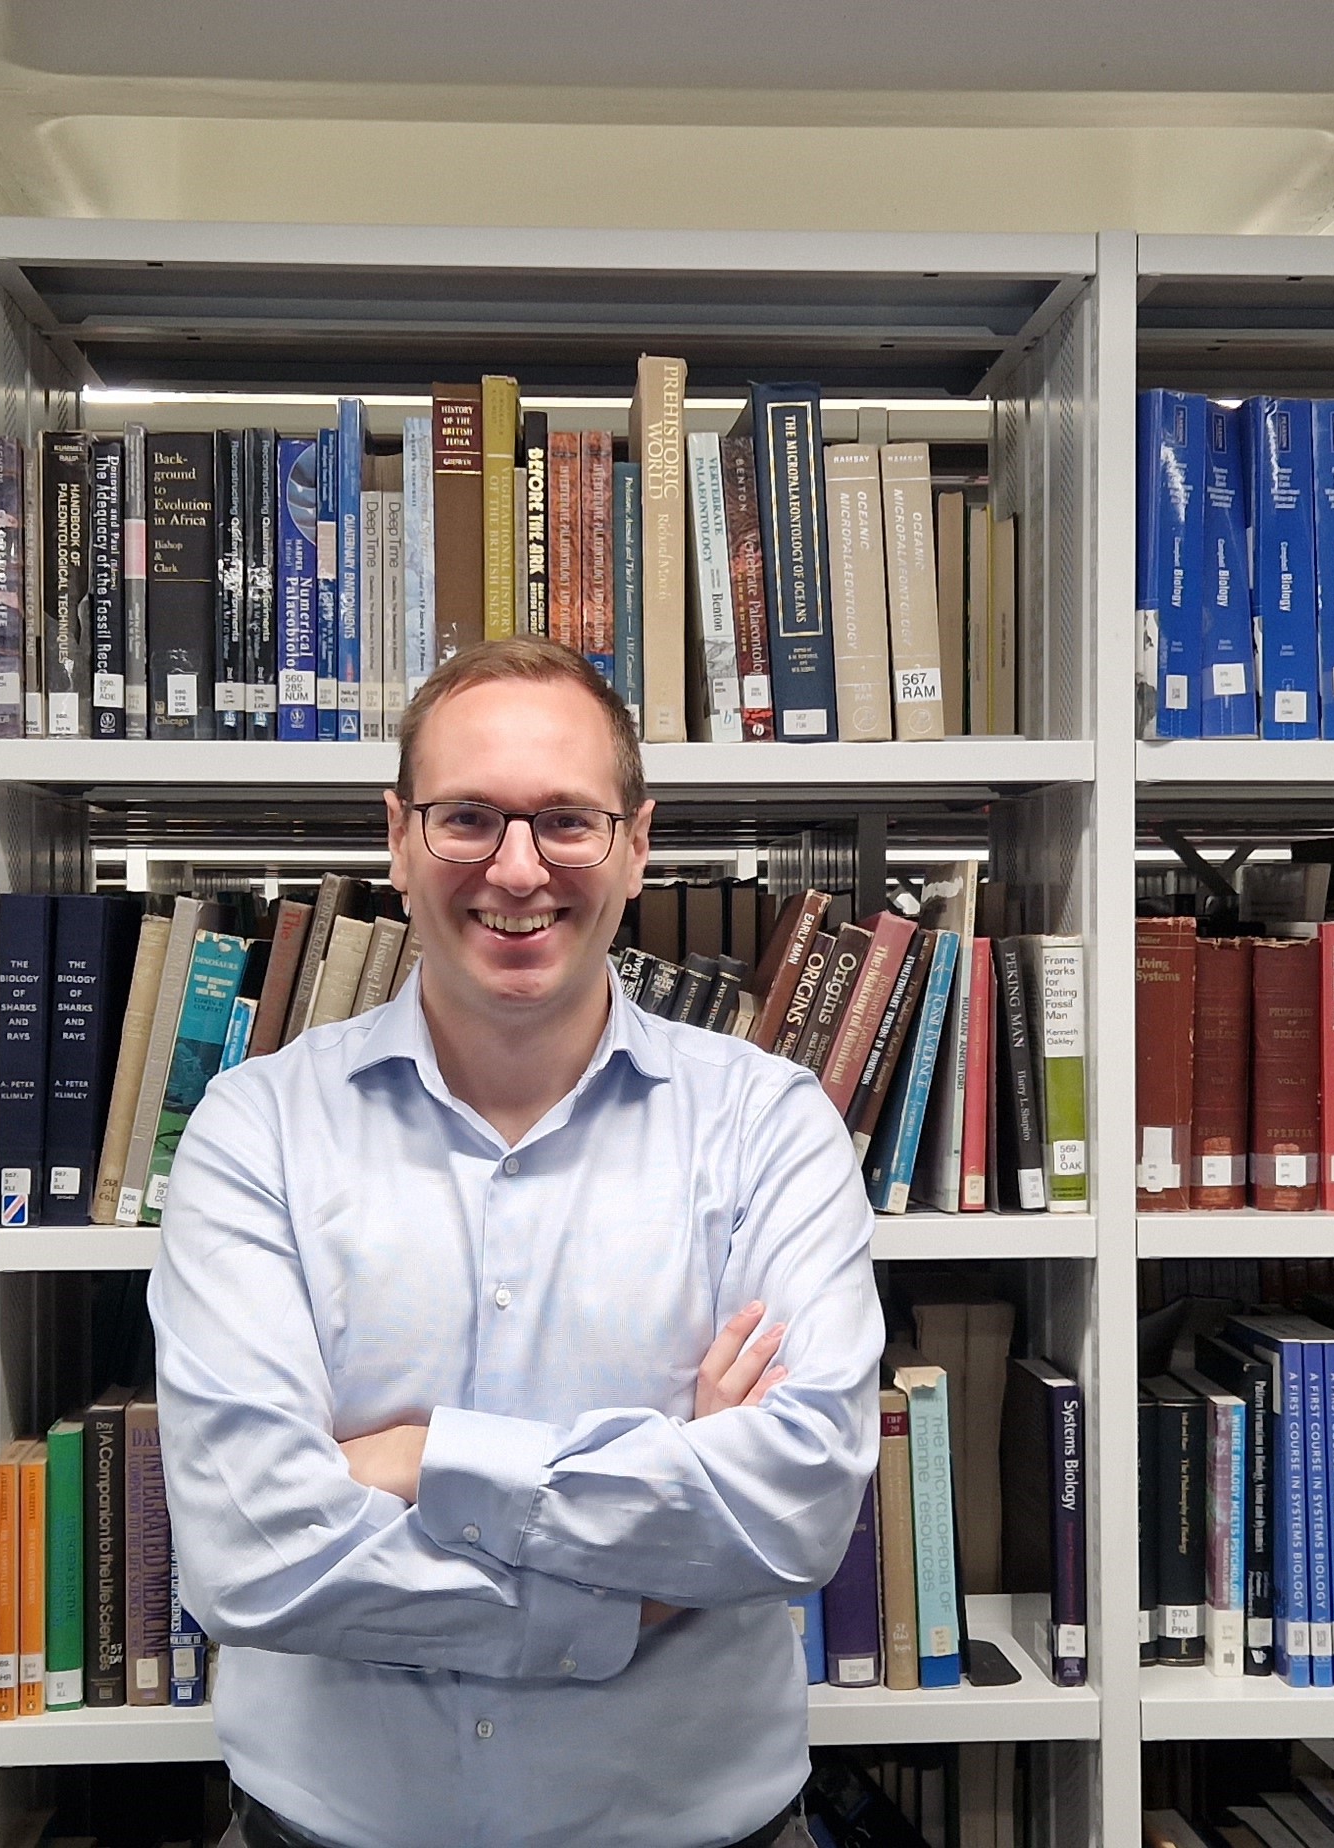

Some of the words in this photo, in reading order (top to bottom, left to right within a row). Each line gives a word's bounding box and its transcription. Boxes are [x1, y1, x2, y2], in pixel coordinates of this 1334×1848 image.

[663, 365, 679, 499] PREHISTORIC
[785, 415, 798, 437] THE
[96, 456, 110, 479] The
[153, 453, 189, 464] Back-
[648, 421, 662, 499] WORLD
[153, 471, 196, 481] ground
[527, 448, 544, 511] BEFORE
[70, 484, 80, 546] HANDBOOK
[91, 484, 111, 550] Adequacy
[154, 499, 211, 510] Evolution
[787, 440, 804, 562] MICROPALAEONTOLOGY
[154, 516, 161, 525] in
[165, 516, 206, 526] Africa
[365, 502, 378, 536] Deep
[387, 502, 400, 536] Deep
[529, 514, 543, 540] THE
[57, 484, 68, 590] PALEONTOLOGICAL
[344, 514, 355, 568] QUATERNARY
[366, 539, 378, 568] Time
[389, 539, 400, 568] Time
[70, 552, 81, 566] OF
[96, 555, 111, 570] of
[529, 543, 544, 575] ARK
[794, 565, 804, 579] OF
[96, 573, 111, 595] the
[1172, 569, 1184, 607] Biology
[1217, 570, 1230, 607] Biology
[1279, 574, 1292, 611] Biology
[96, 601, 111, 638] Fossil
[299, 577, 312, 657] Numerical
[343, 572, 357, 639] ENVIRONMENTS
[794, 582, 807, 623] OCEANS
[57, 594, 68, 665] TECHNIQUES
[902, 674, 927, 686] 567
[902, 688, 936, 698] RAM
[794, 913, 816, 941] EARLY
[69, 961, 87, 969] THE
[788, 935, 806, 964] MAN
[57, 975, 96, 983] BIOLOGY
[785, 952, 825, 1026] ORIGINS
[818, 952, 858, 1025] Origins
[1005, 952, 1019, 1007] PEKING
[58, 1004, 93, 1012] SHARKS
[1010, 1013, 1024, 1048] MAN
[1289, 1372, 1298, 1380] A
[1289, 1385, 1299, 1417] FIRST
[99, 1435, 112, 1446] A
[1062, 1400, 1079, 1455] Systems
[1290, 1422, 1300, 1472] COURSE
[96, 1448, 114, 1536] Companion
[1061, 1460, 1079, 1510] Biology
[1291, 1475, 1301, 1489] IN
[1292, 1494, 1302, 1548] SYSTEMS
[99, 1538, 113, 1551] to
[100, 1554, 114, 1577] the
[1292, 1553, 1304, 1608] BIOLOGY
[100, 1579, 114, 1603] Life
[99, 1604, 114, 1671] Sciences
